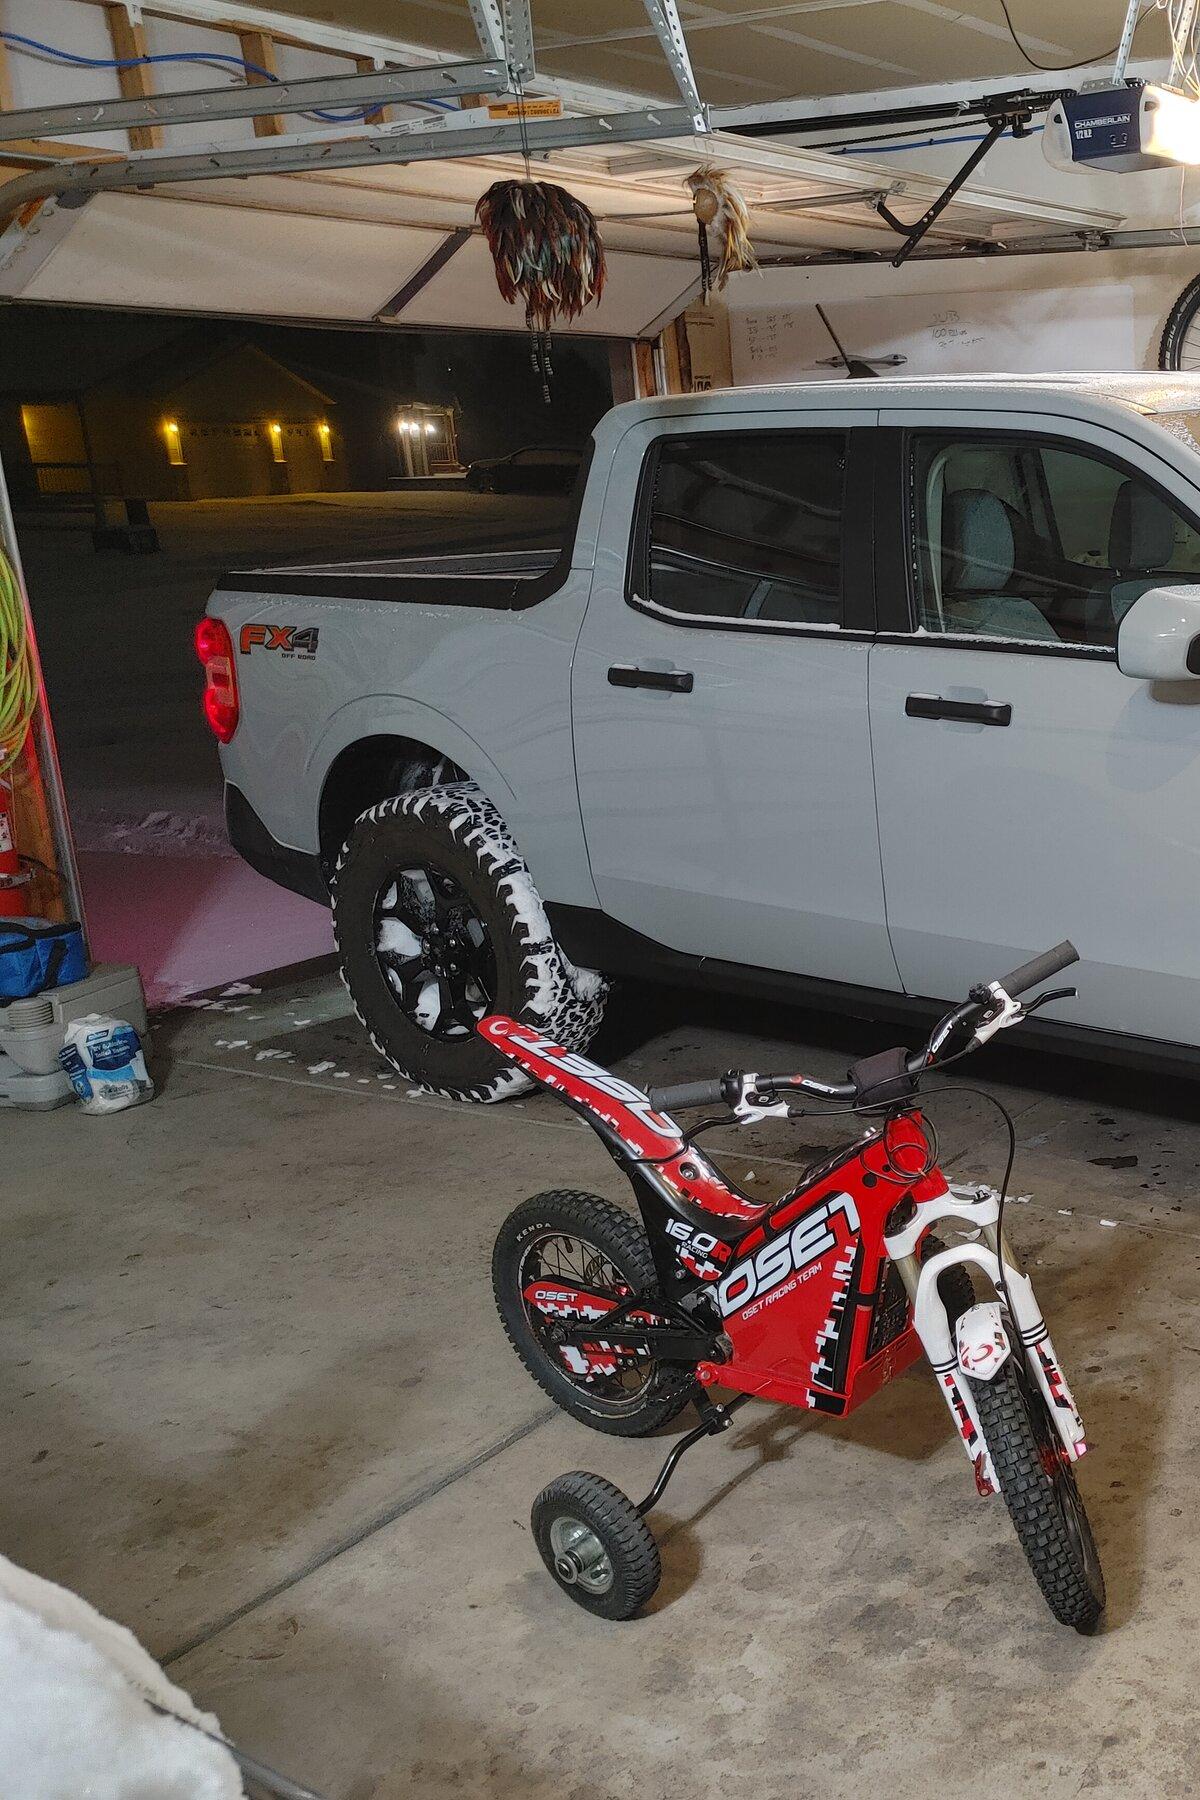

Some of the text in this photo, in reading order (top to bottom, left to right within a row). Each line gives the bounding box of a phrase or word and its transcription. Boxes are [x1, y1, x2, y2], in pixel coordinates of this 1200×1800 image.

[1074, 115, 1131, 129] CHAMBERLAIN
[240, 623, 320, 655] FX4
[932, 1021, 954, 1054] OSET
[507, 1034, 684, 1138] OSET
[801, 1079, 839, 1095] OSET
[516, 1222, 552, 1243] KENDA
[664, 1217, 732, 1263] 16.0R
[681, 1241, 708, 1259] RACING
[718, 1191, 861, 1318] OSET
[534, 1290, 578, 1303] OSET
[742, 1262, 822, 1321] OSET RACING TEAM
